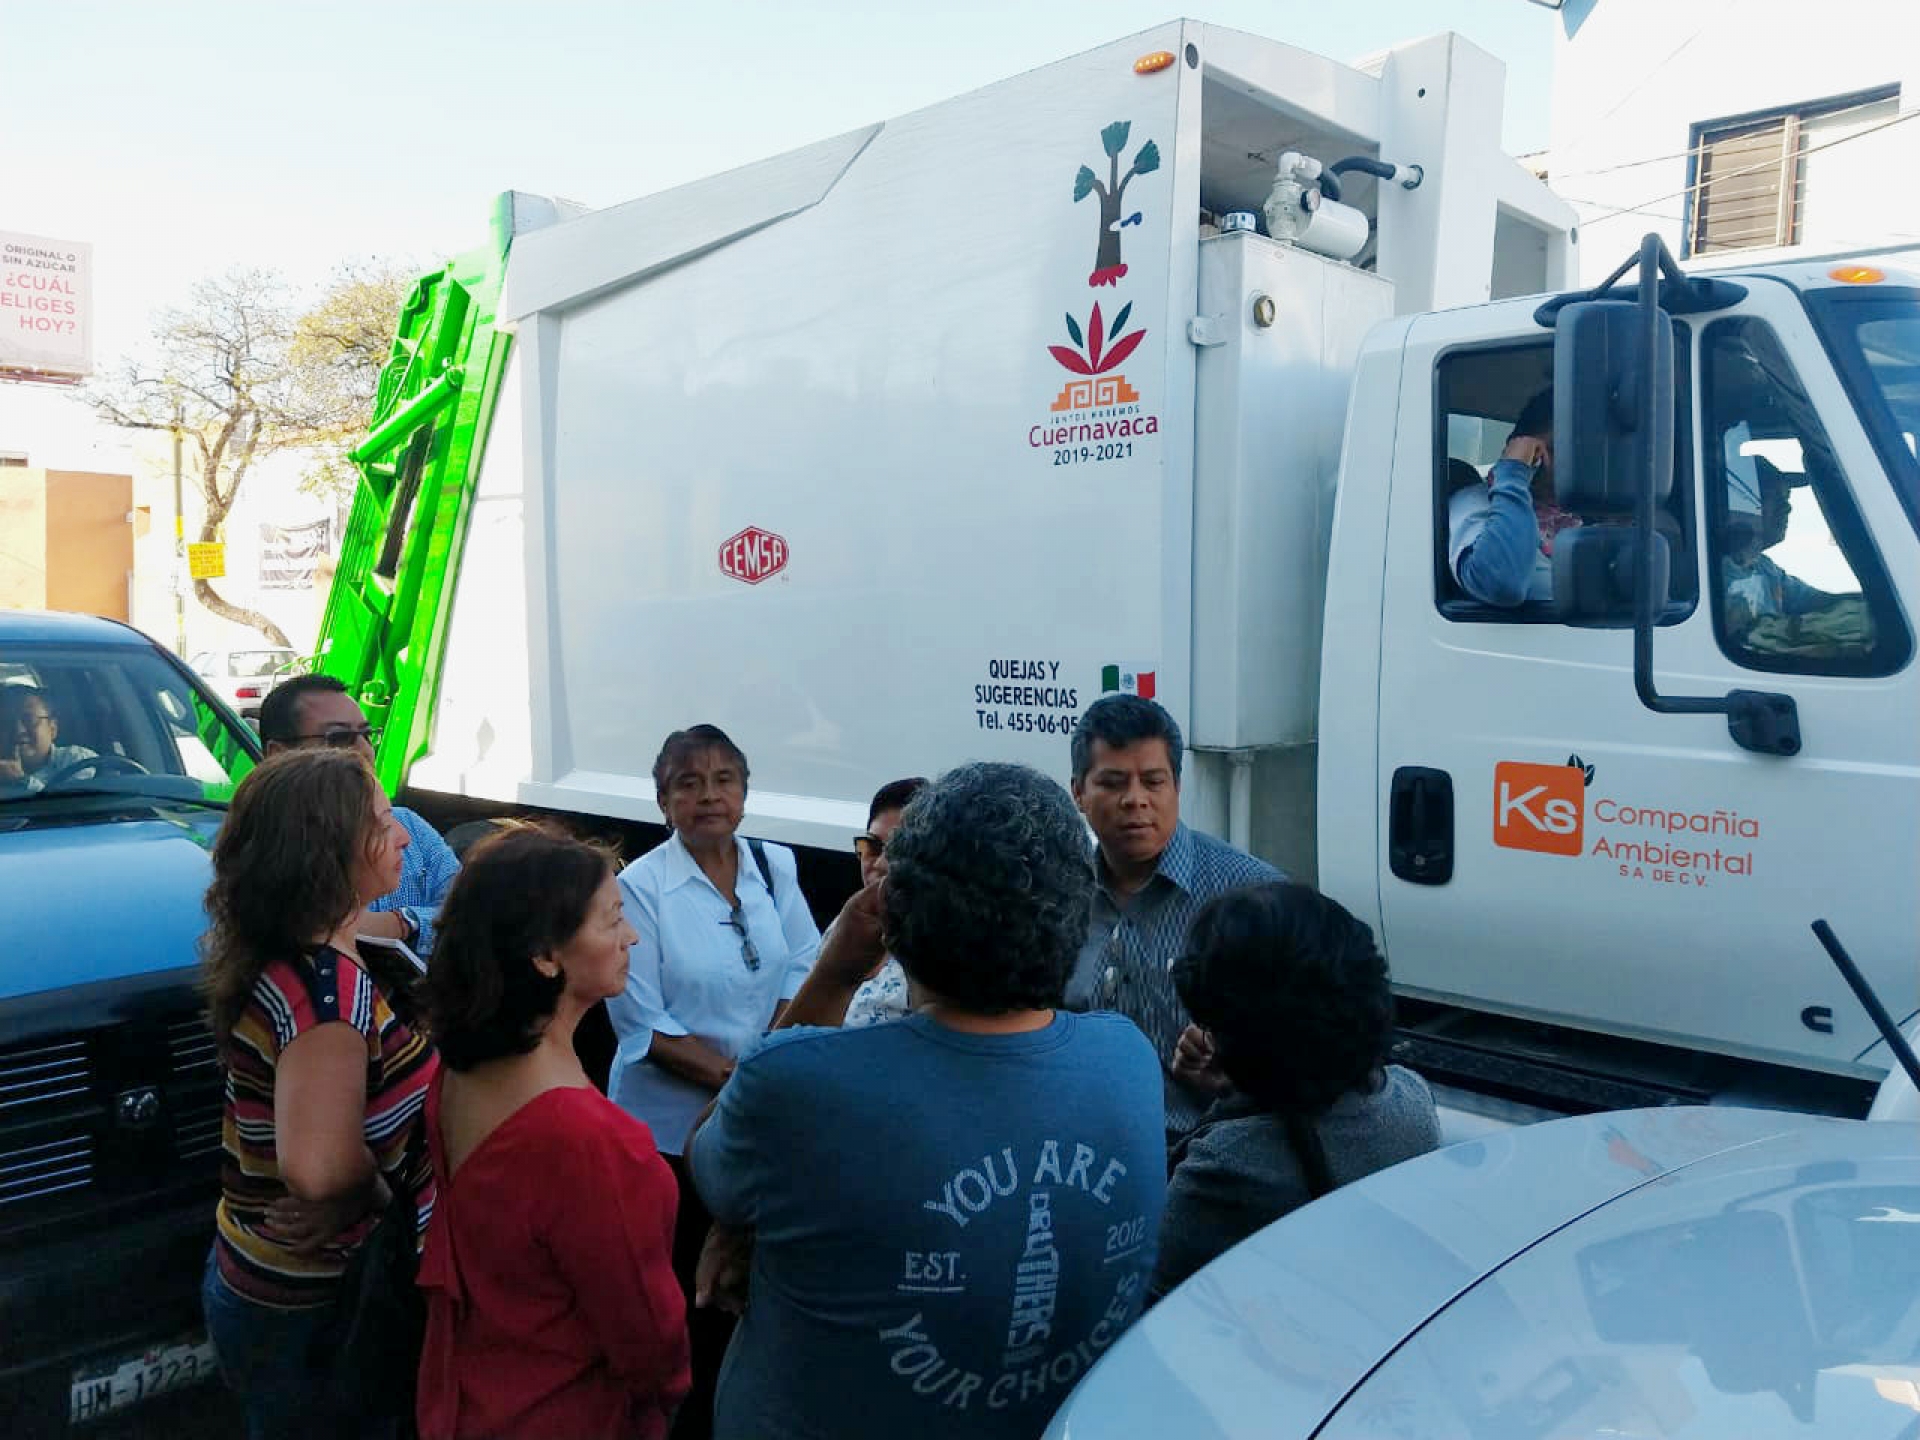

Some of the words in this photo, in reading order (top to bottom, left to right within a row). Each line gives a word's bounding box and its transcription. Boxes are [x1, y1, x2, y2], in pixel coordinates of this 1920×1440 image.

[2, 254, 22, 265] SIN
[5, 244, 63, 261] ORIGINAL
[6, 272, 75, 295] ¿CUÁL
[0, 292, 75, 315] ELIGES
[20, 314, 76, 335] HOY?
[1028, 416, 1158, 447] Cuernavaca
[1053, 441, 1132, 466] 2019-2021
[722, 535, 783, 577] CEMSA
[989, 659, 1045, 680] QUEJAS
[1049, 660, 1060, 681] Y
[974, 684, 1078, 709] SUGERENCIAS
[976, 710, 1003, 730] Tel.
[1500, 781, 1577, 835] Ks
[1592, 836, 1752, 877] Ambiental
[924, 1147, 1019, 1228] YOU
[1033, 1140, 1127, 1204] ARE
[905, 1251, 967, 1282] EST.
[879, 1311, 984, 1410] YOUR
[987, 1271, 1140, 1409] CHOICES
